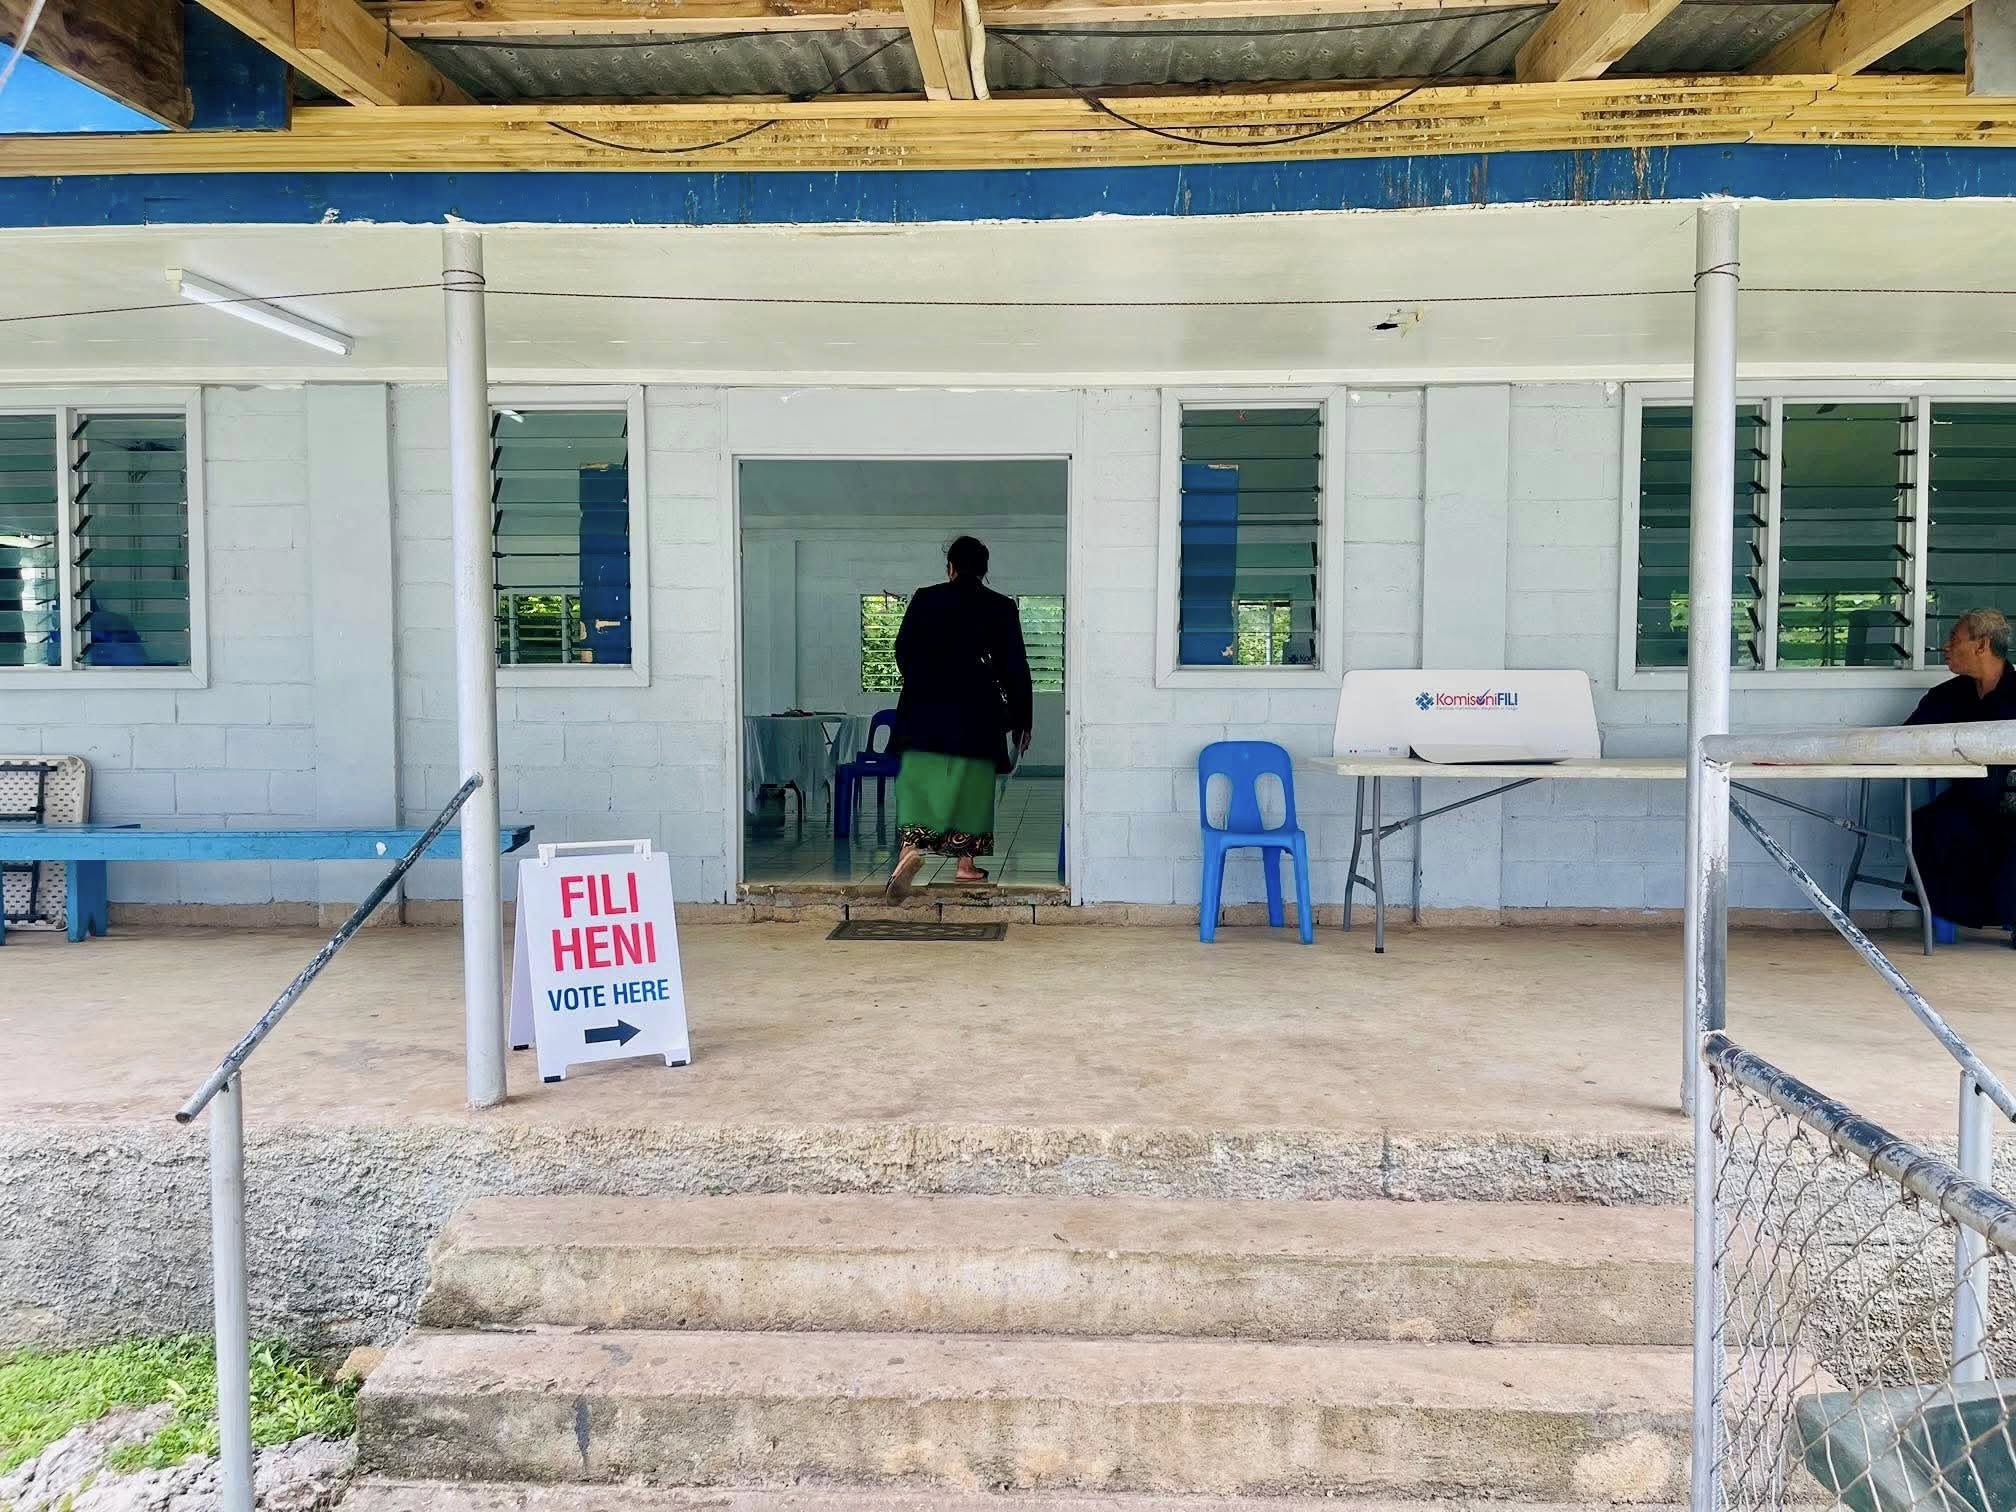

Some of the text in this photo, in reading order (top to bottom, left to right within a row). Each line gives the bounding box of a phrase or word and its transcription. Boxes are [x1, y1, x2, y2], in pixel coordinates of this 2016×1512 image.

[560, 872, 639, 918] FILI
[552, 921, 656, 972] HENI
[548, 978, 670, 1012] VOTE HERE
